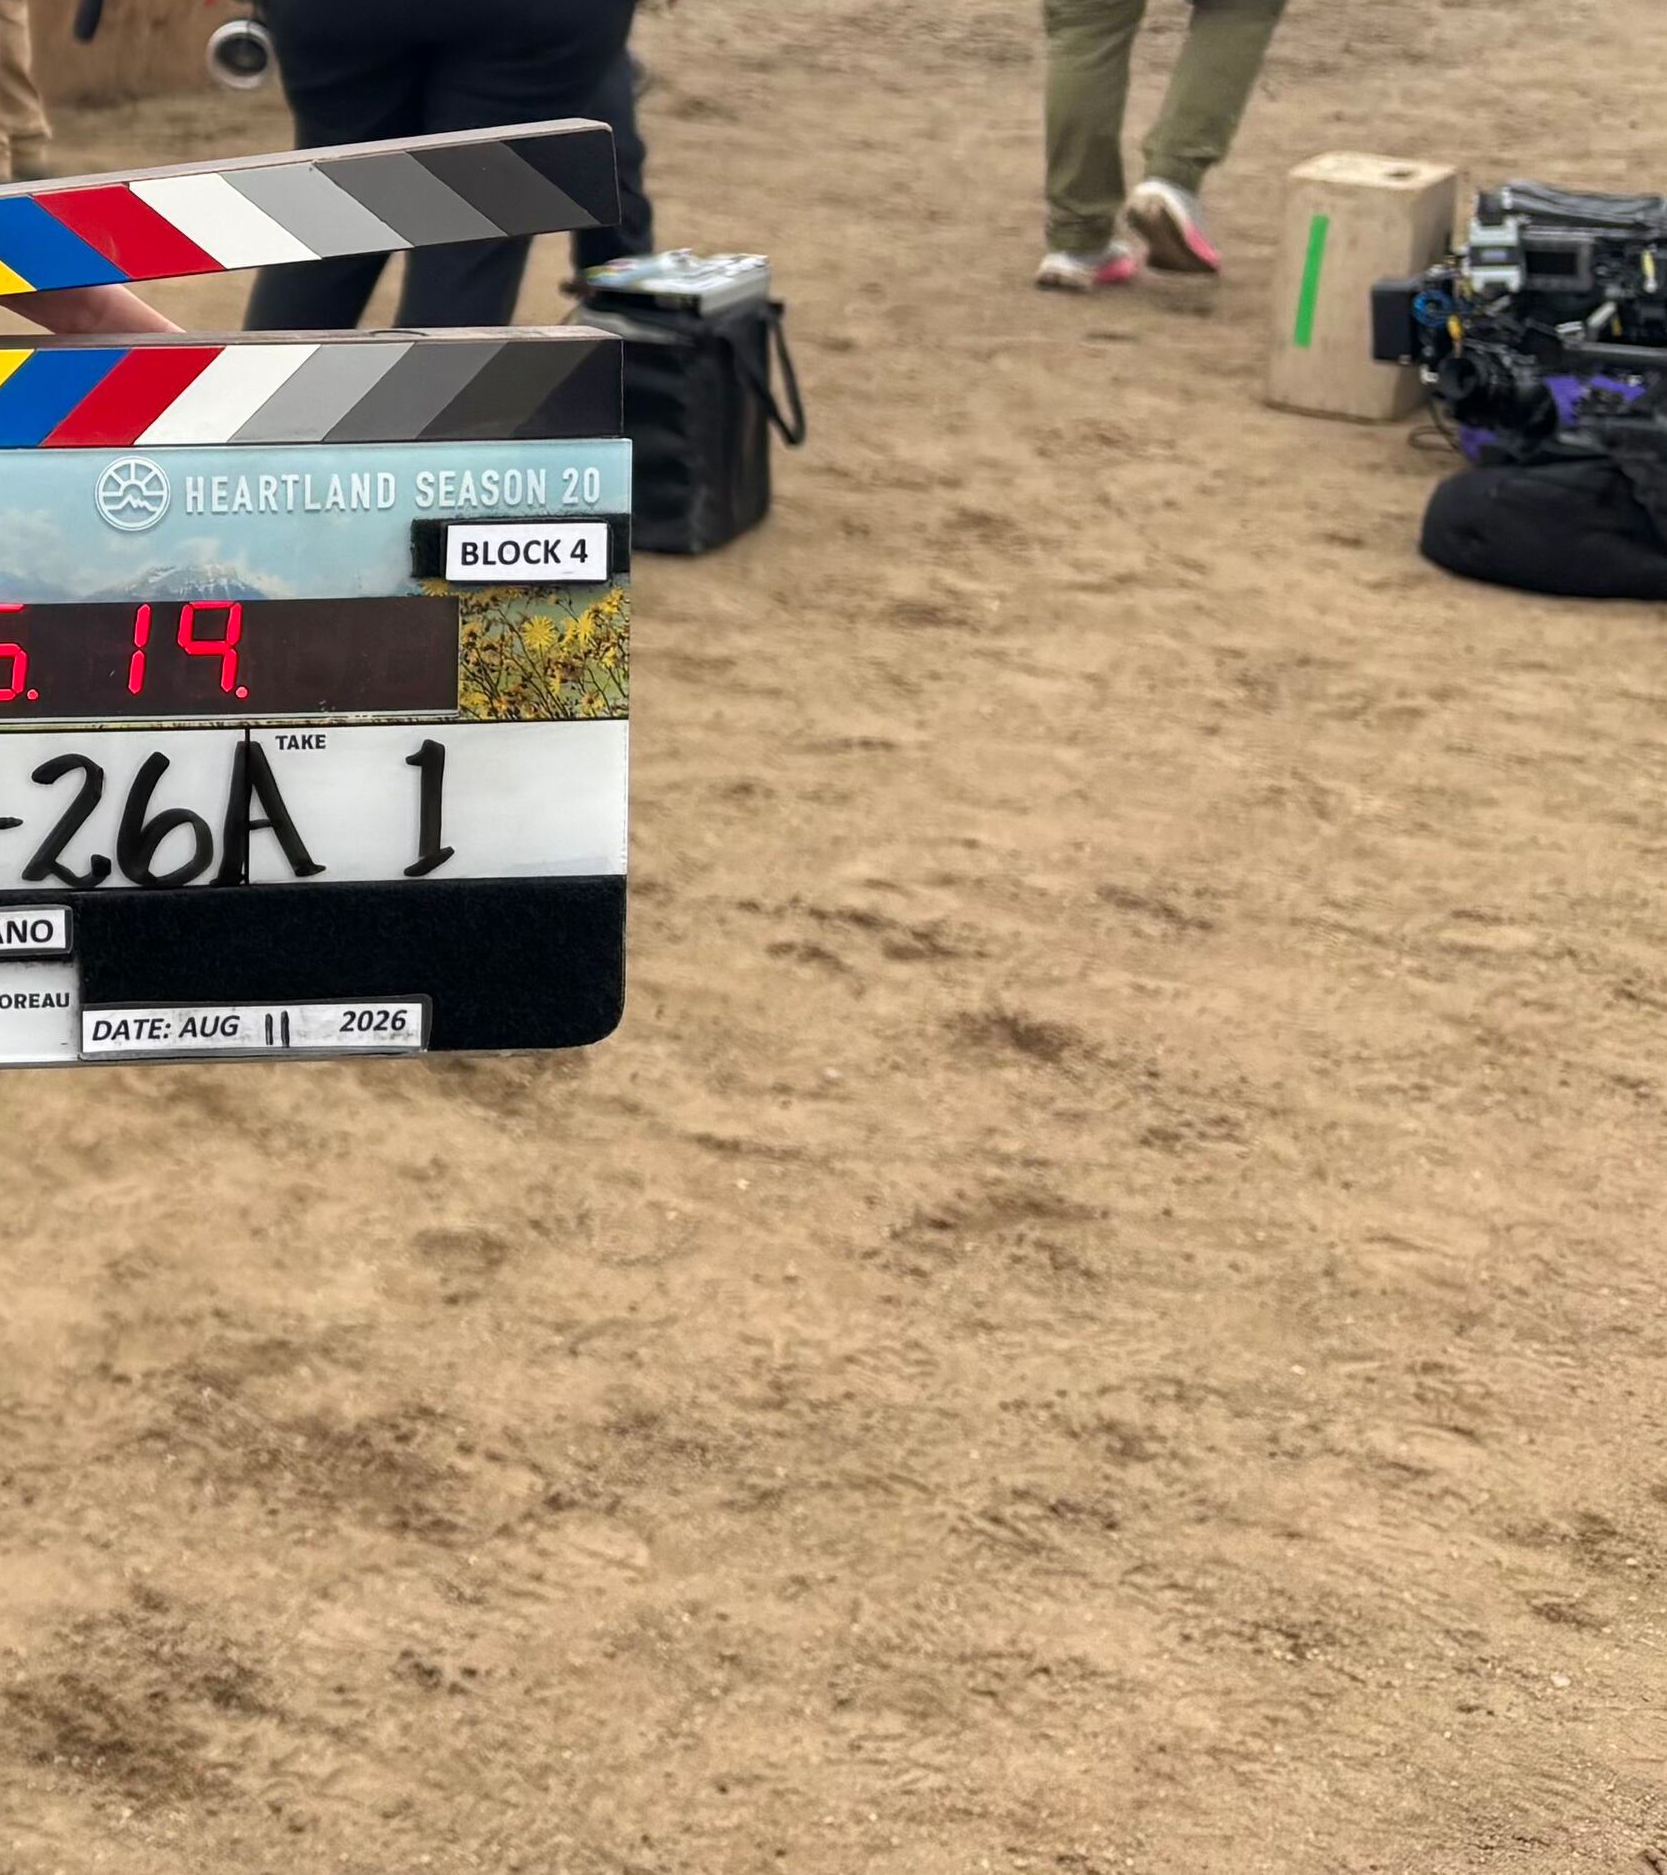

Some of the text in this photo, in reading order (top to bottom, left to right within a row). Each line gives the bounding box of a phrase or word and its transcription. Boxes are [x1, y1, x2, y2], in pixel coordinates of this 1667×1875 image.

[184, 466, 601, 514] HEARTLAND SEASON 20
[460, 538, 588, 566] BLOCK 4
[275, 734, 327, 751] TAKE
[404, 739, 455, 877] 1
[91, 1017, 172, 1043] DATE:
[178, 1014, 241, 1039] AUG
[339, 1008, 408, 1034] 2026
